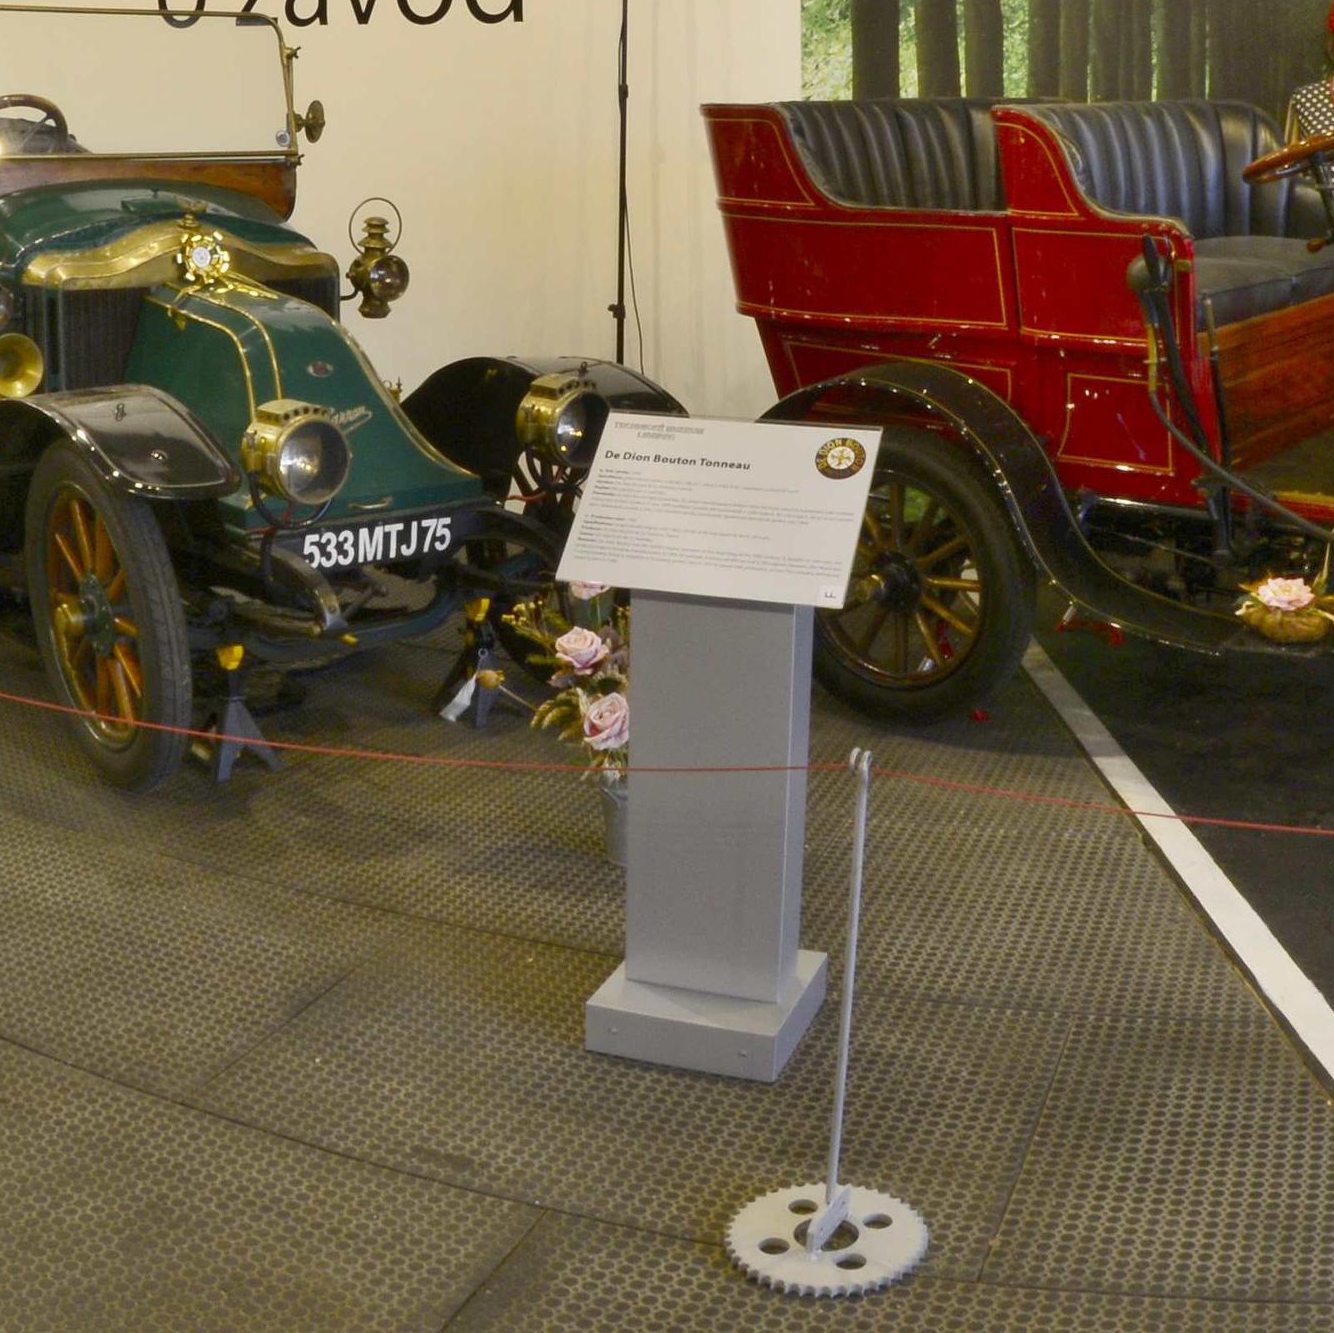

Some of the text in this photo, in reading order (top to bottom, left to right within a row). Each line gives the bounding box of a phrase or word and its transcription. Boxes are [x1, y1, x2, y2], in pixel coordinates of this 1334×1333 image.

[604, 450, 752, 471] De Dion Bouton Tonneau
